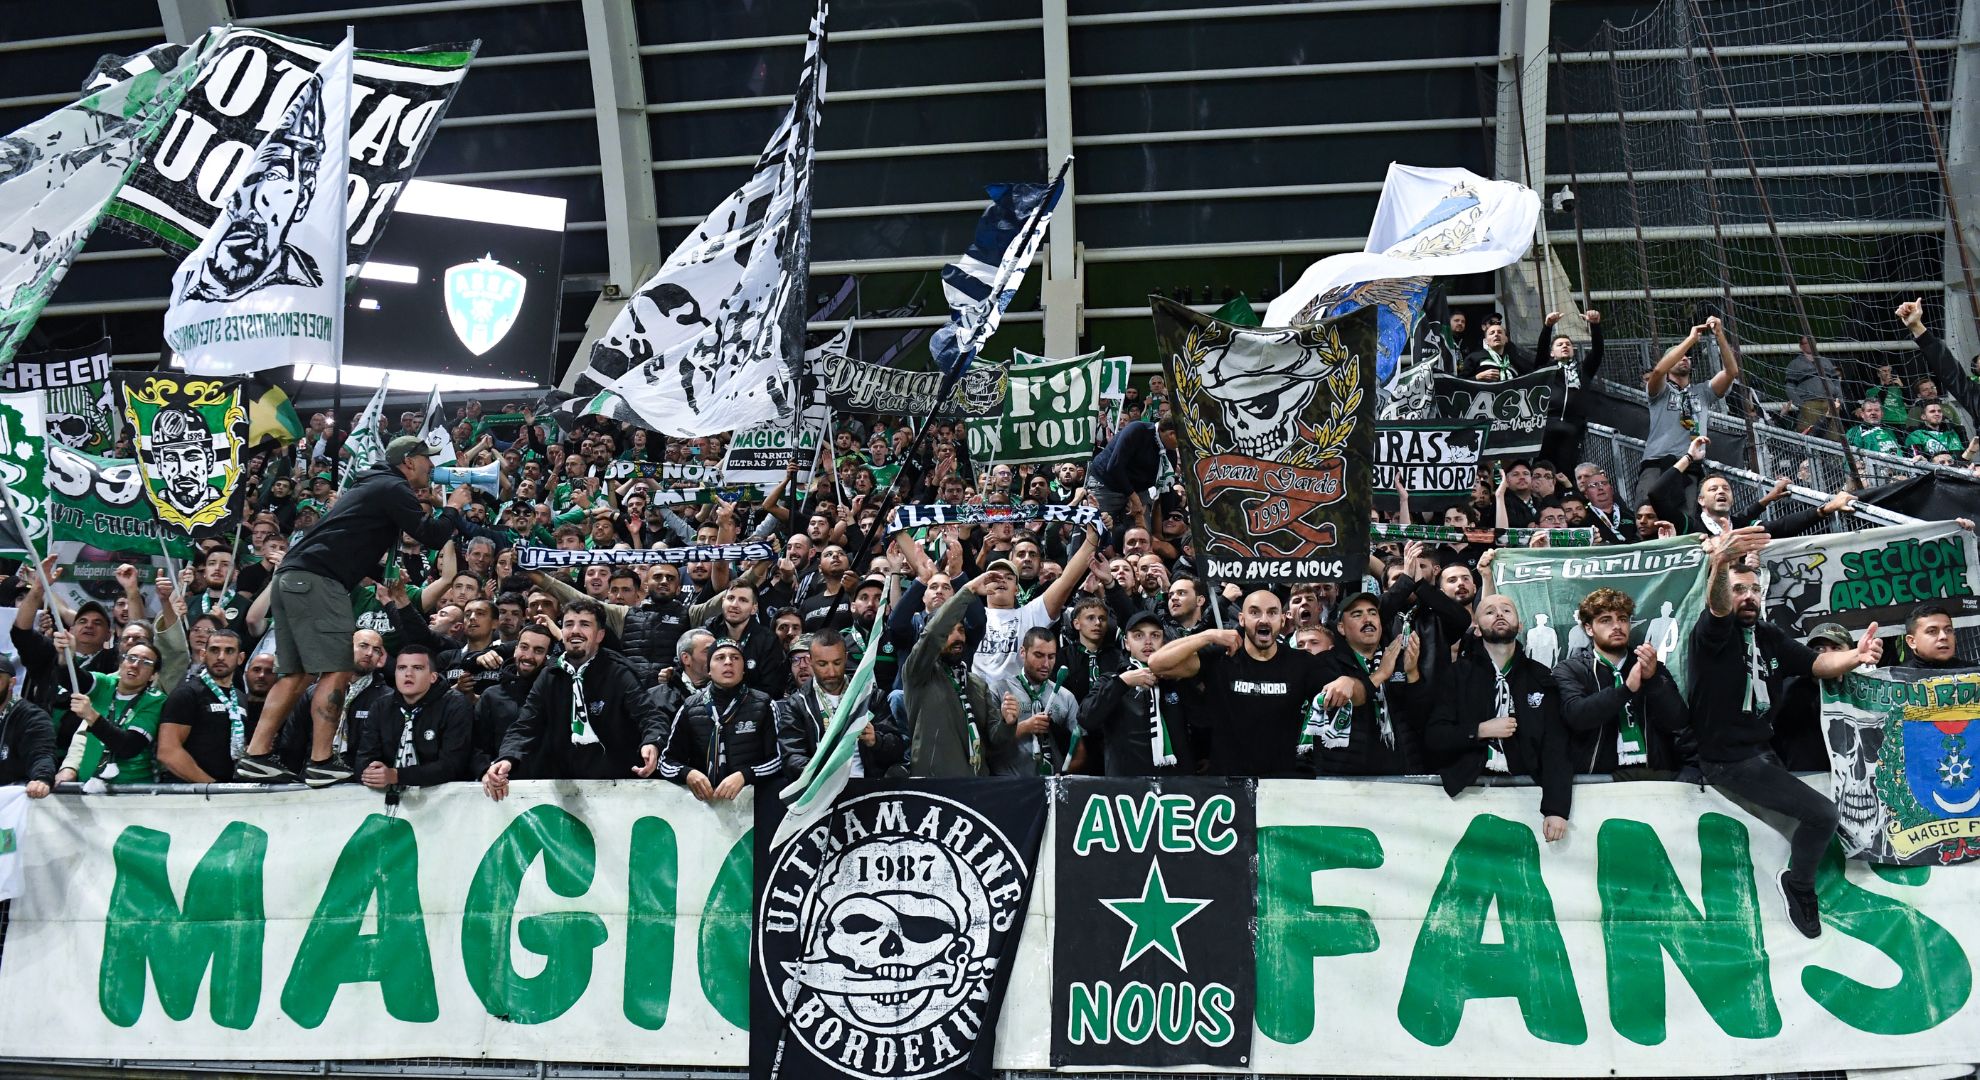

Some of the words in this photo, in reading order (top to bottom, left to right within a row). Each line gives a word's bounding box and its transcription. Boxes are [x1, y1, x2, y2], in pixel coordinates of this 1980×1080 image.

[733, 430, 786, 448] MAGIC
[730, 459, 767, 467] ULTRAS
[754, 452, 800, 460] WARNIN
[1264, 467, 1338, 494] Garde
[1423, 465, 1476, 490] NORD
[1253, 499, 1290, 532] 1999
[517, 543, 771, 571] ULTRAMARINES
[1207, 559, 1243, 578] DUCO
[1245, 560, 1292, 579] AVEC
[1296, 560, 1343, 578] NOUS
[1562, 545, 1706, 578] Gardons
[1829, 566, 1974, 613] ARDECHE
[1261, 682, 1287, 694] NORD
[1073, 792, 1238, 855] AVEC
[1907, 821, 1960, 845] MAGIC
[766, 800, 1022, 933] ULTRAMARINES
[858, 855, 936, 882] 1987
[1255, 812, 1972, 1047] FANS
[1068, 981, 1235, 1047] NOUS
